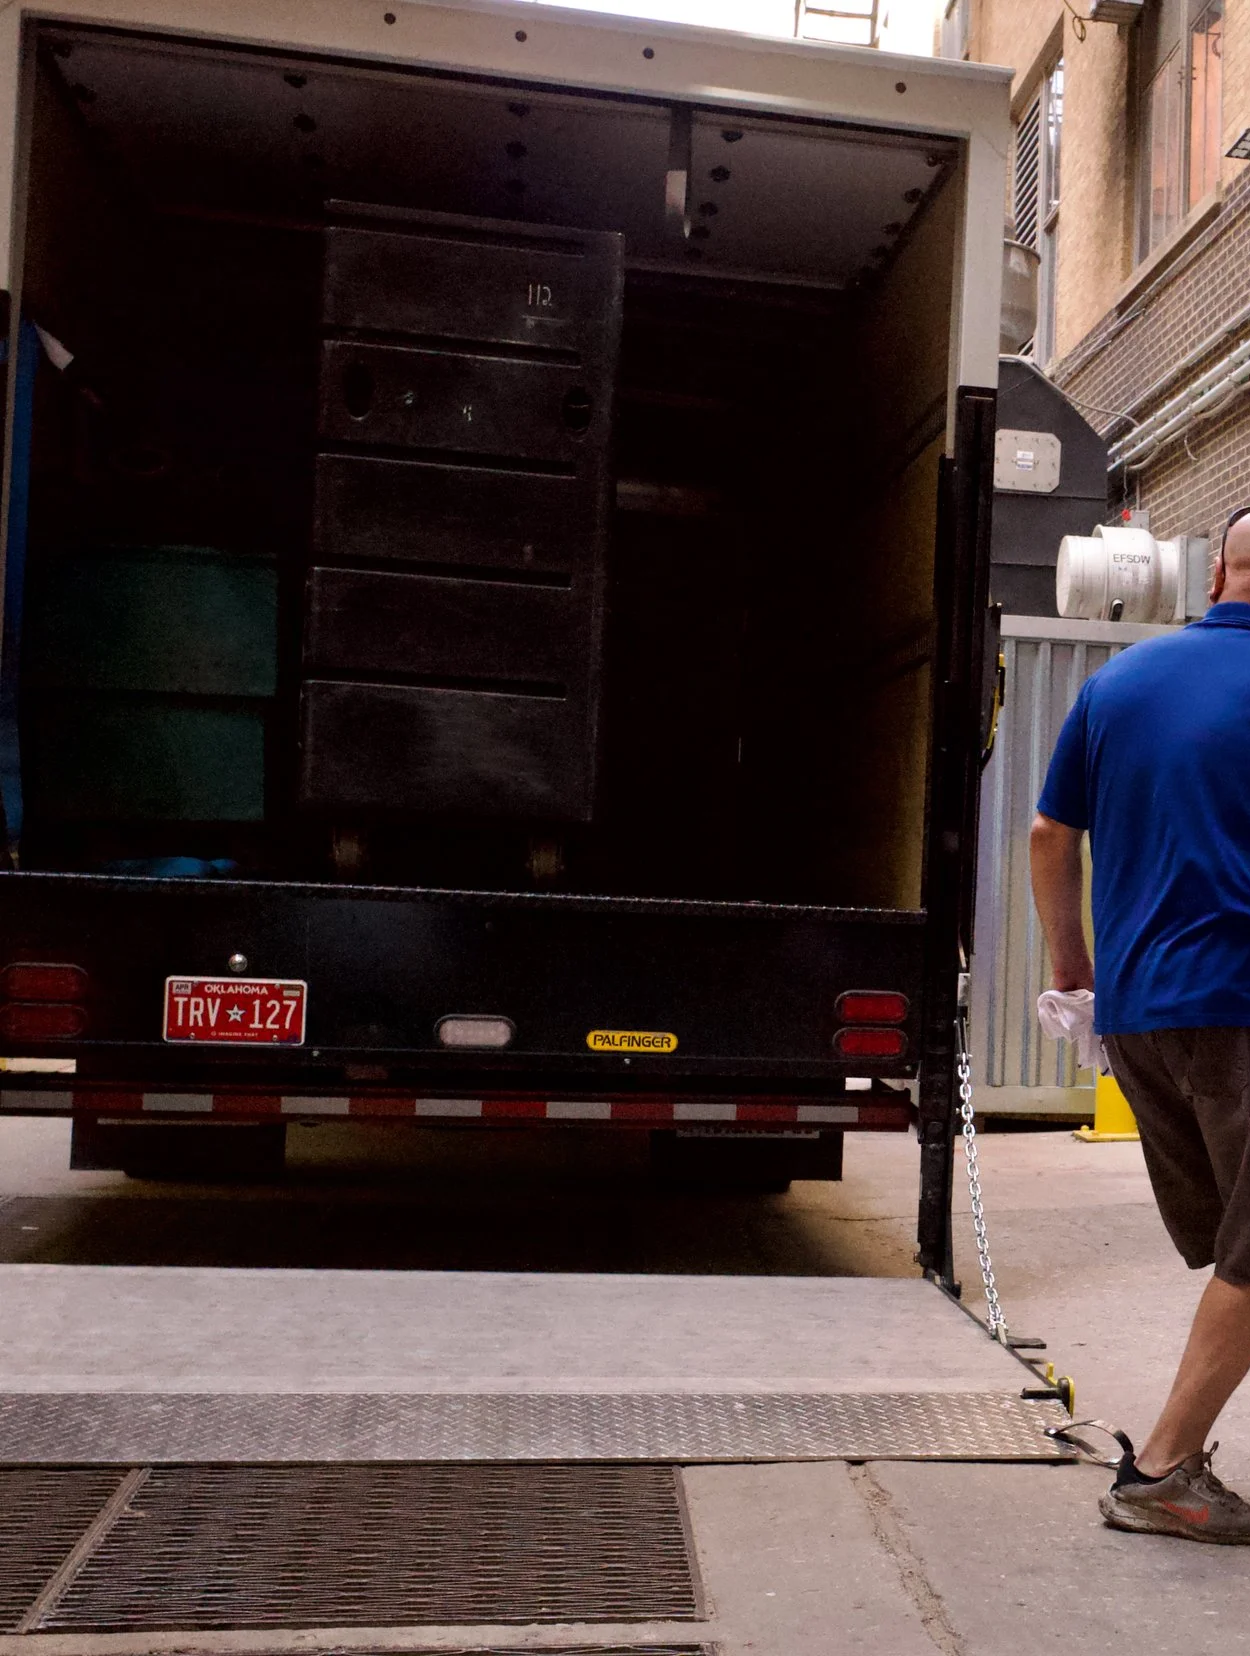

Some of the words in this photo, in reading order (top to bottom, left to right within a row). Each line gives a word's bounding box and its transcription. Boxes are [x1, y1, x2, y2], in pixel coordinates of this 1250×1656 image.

[204, 983, 269, 996] OKLAHOMA
[173, 996, 222, 1028] TRV
[249, 999, 297, 1030] 127
[593, 1034, 673, 1049] PALFINGER
